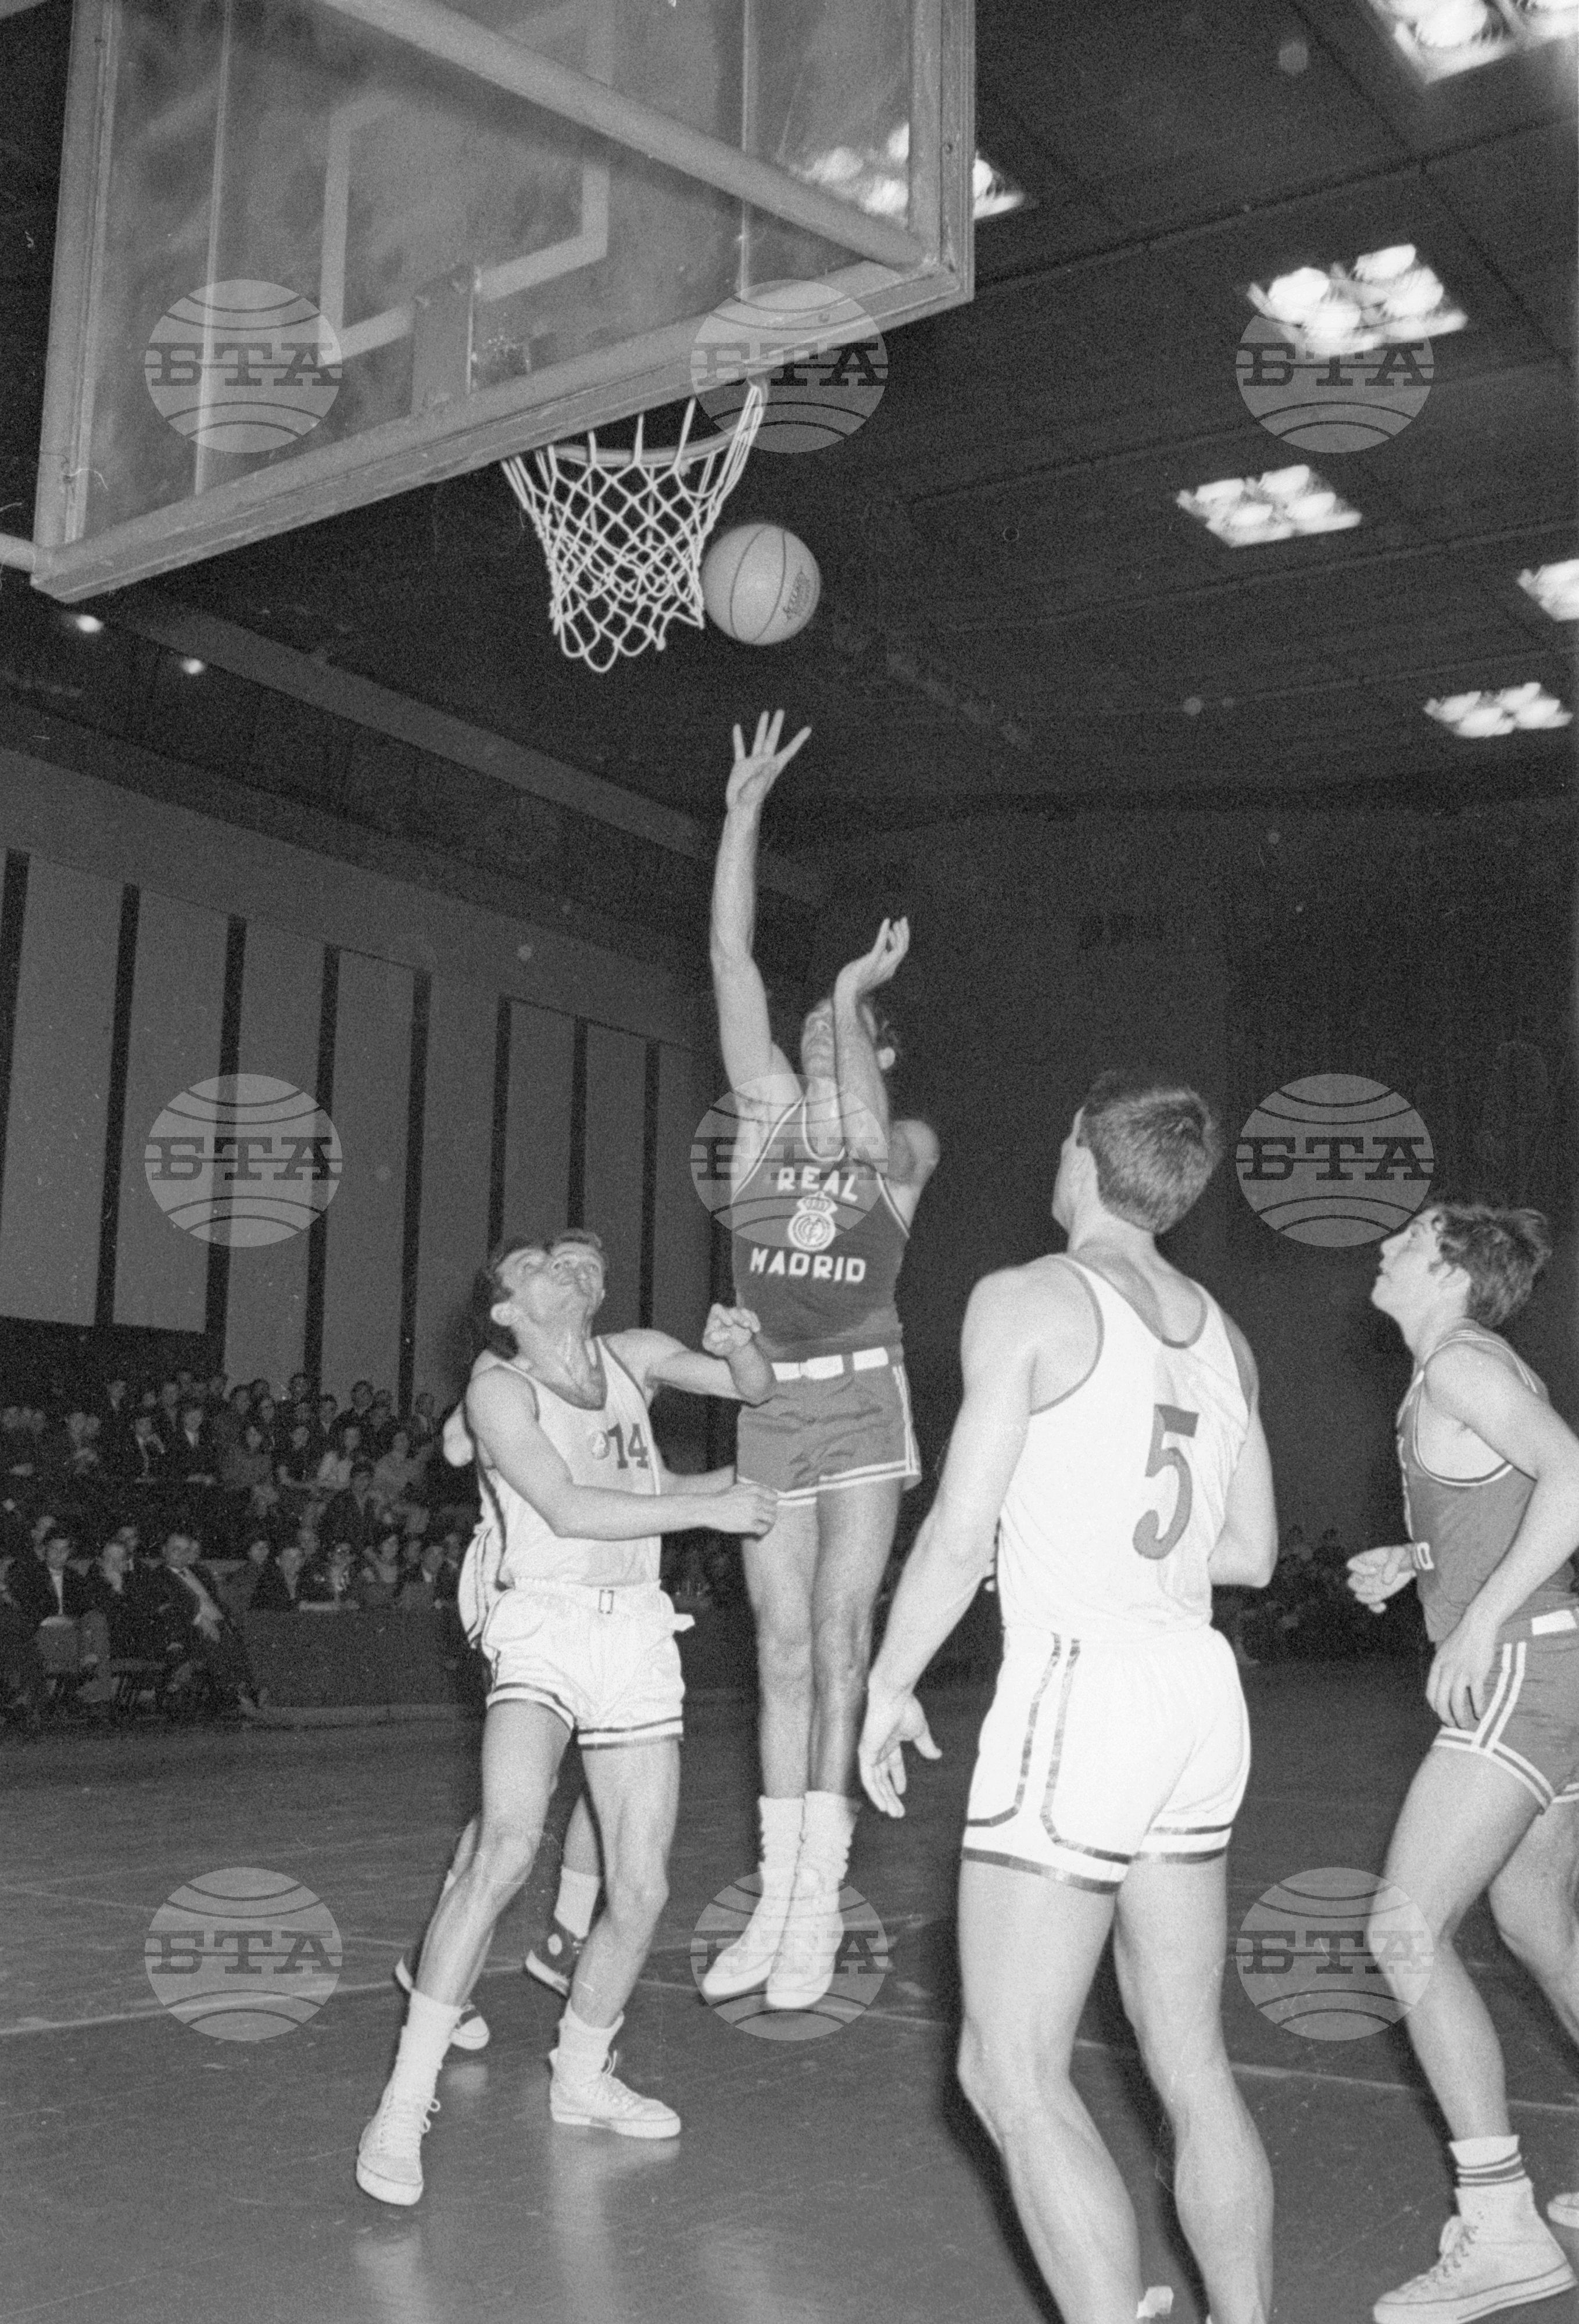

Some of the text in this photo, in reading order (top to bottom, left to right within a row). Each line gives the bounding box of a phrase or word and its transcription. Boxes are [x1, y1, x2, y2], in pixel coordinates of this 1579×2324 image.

[776, 1165, 858, 1202] REAL
[750, 1247, 866, 1283] MADRID
[607, 1423, 649, 1469] 14
[1132, 1403, 1199, 1560] 5
